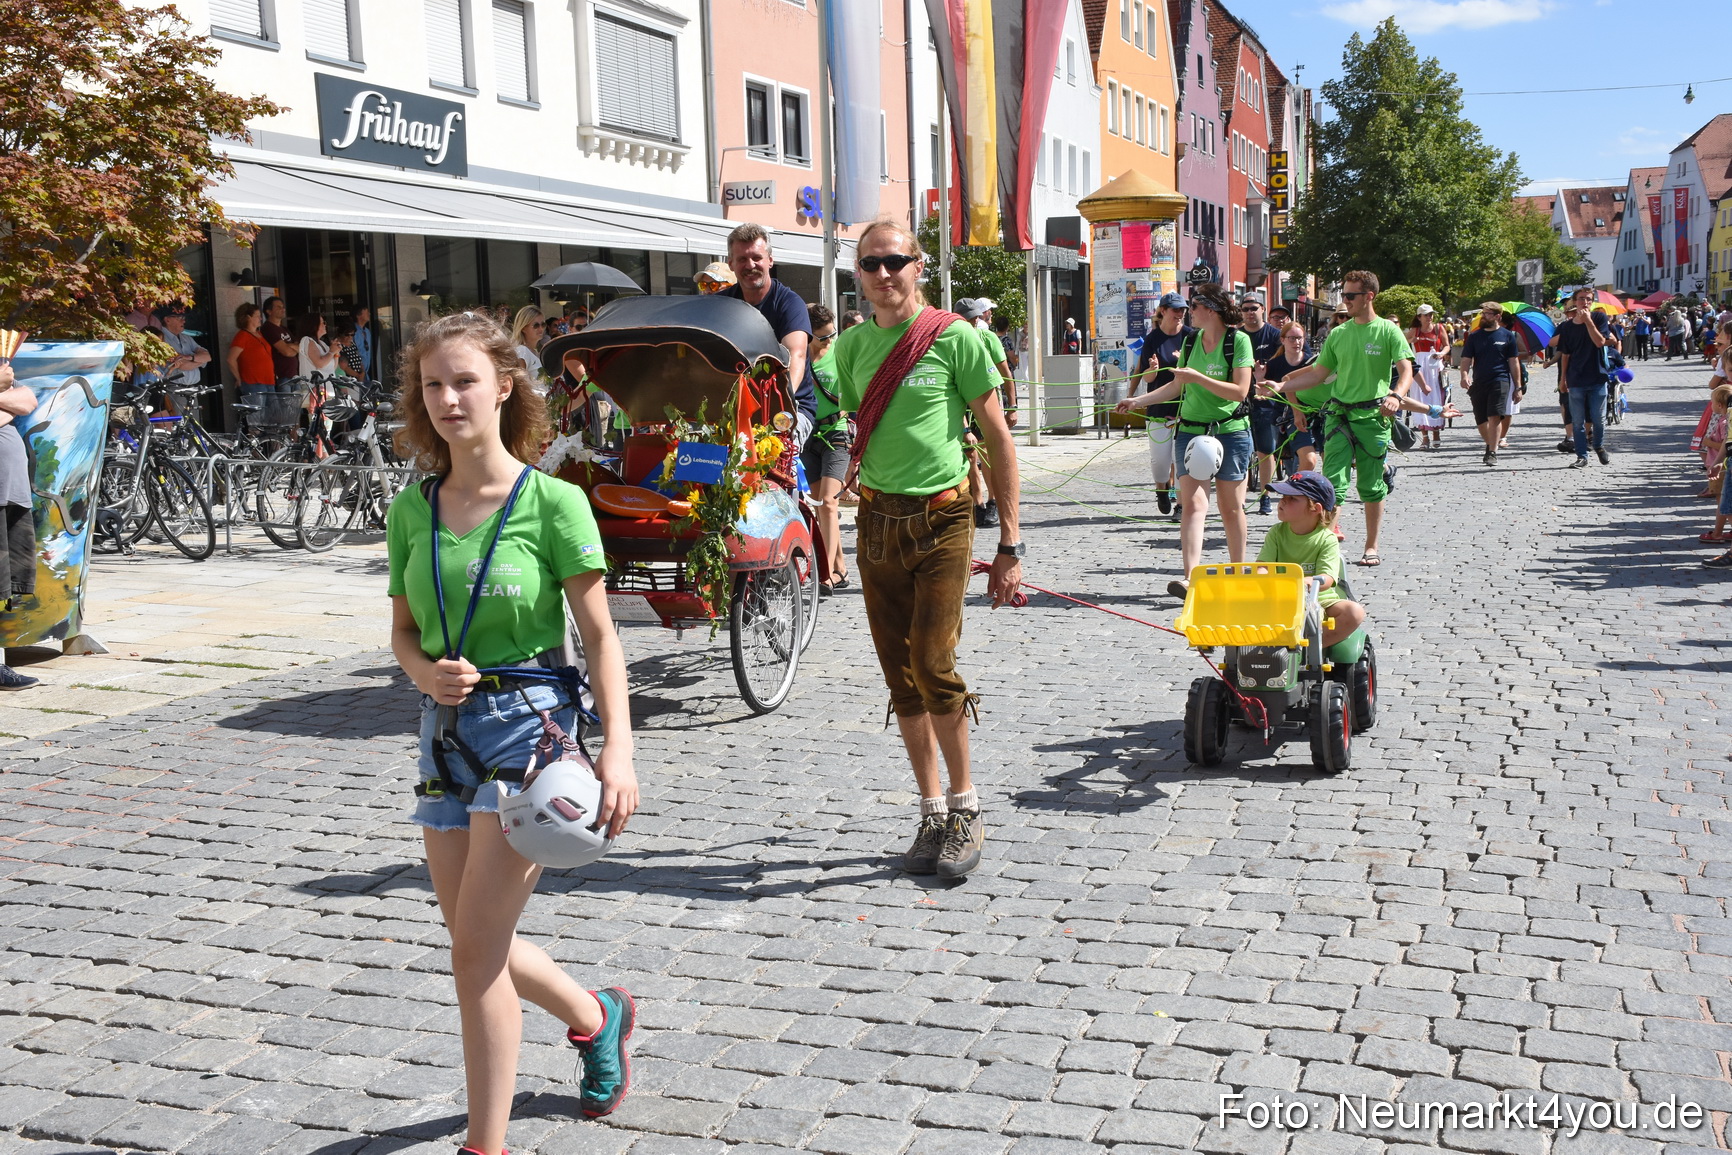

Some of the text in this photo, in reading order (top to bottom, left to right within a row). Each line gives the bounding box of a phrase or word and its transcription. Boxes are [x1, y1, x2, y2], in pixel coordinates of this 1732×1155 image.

[331, 90, 463, 165] frühauf
[1270, 153, 1288, 249] HOTEL
[901, 377, 936, 387] TEAM
[692, 457, 723, 466] Lebenshilfe
[466, 584, 521, 597] TEAM
